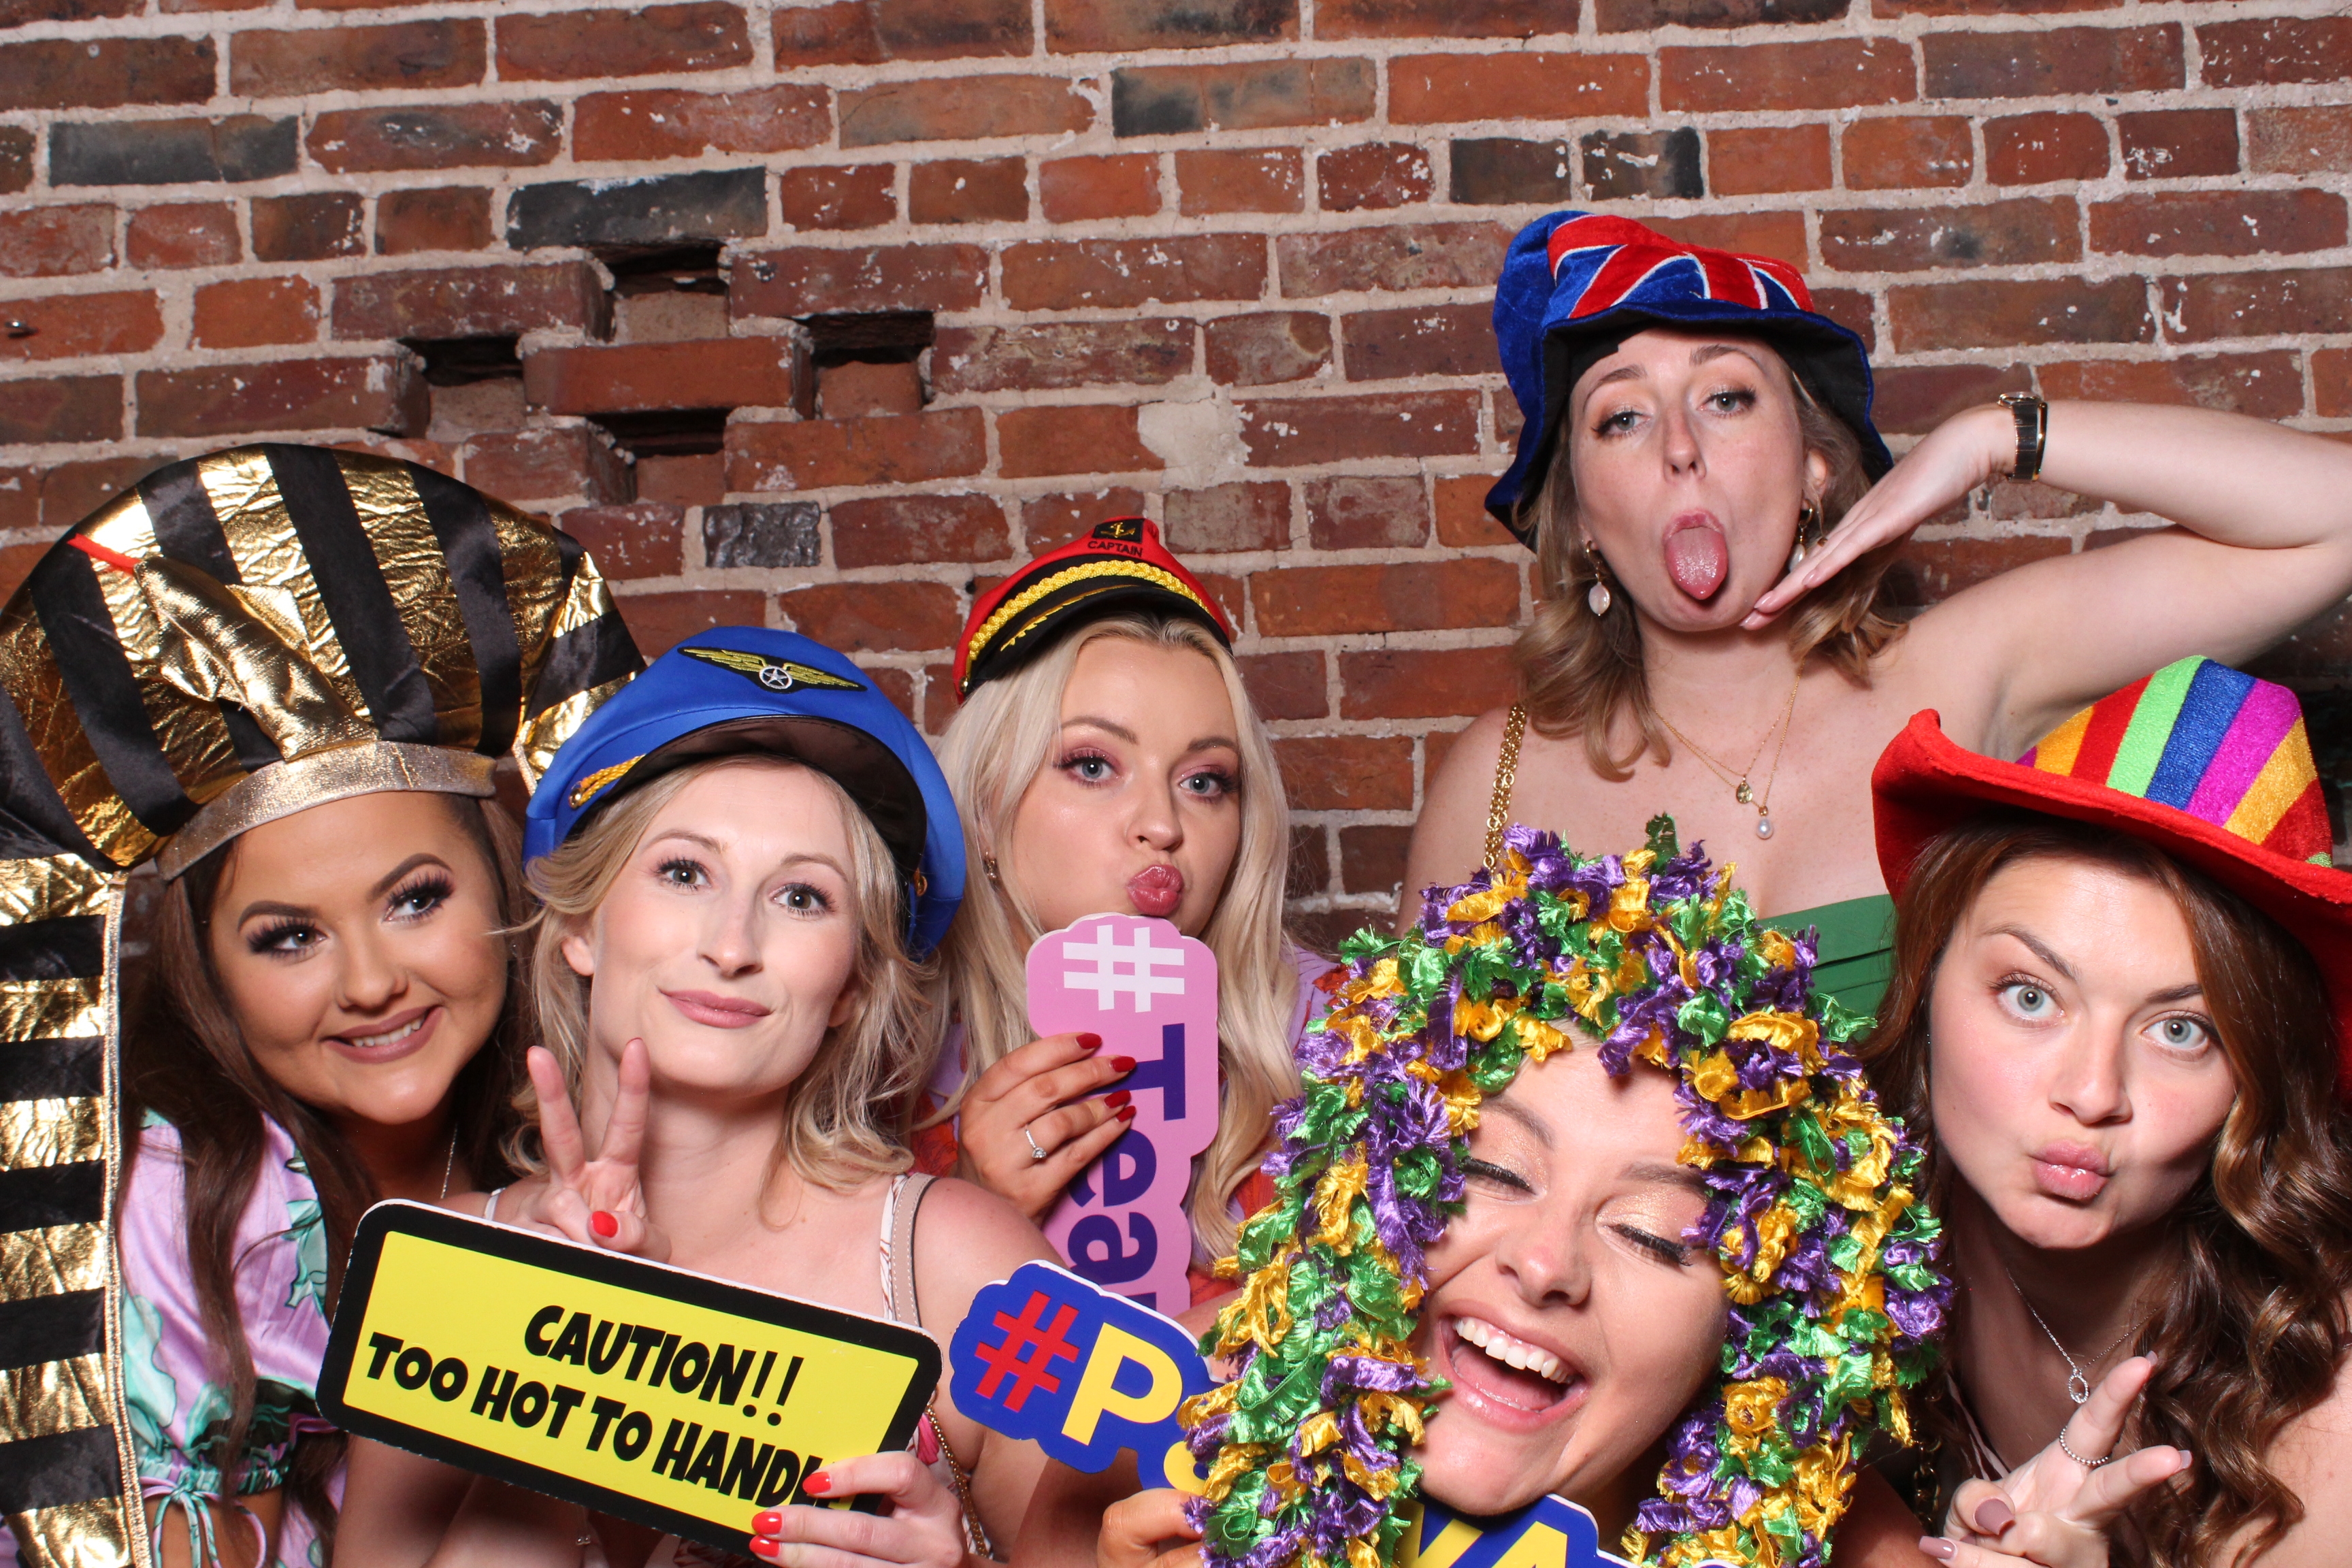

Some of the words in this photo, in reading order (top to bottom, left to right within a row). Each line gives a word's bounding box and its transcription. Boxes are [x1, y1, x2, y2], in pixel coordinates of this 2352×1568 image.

[1088, 540, 1143, 557] CAPTAIN
[1062, 924, 1186, 1312] #Tea
[367, 1332, 468, 1402] TOO
[470, 1365, 586, 1439] HOT
[586, 1396, 653, 1462] TO
[524, 1305, 804, 1426] CAUTION!!
